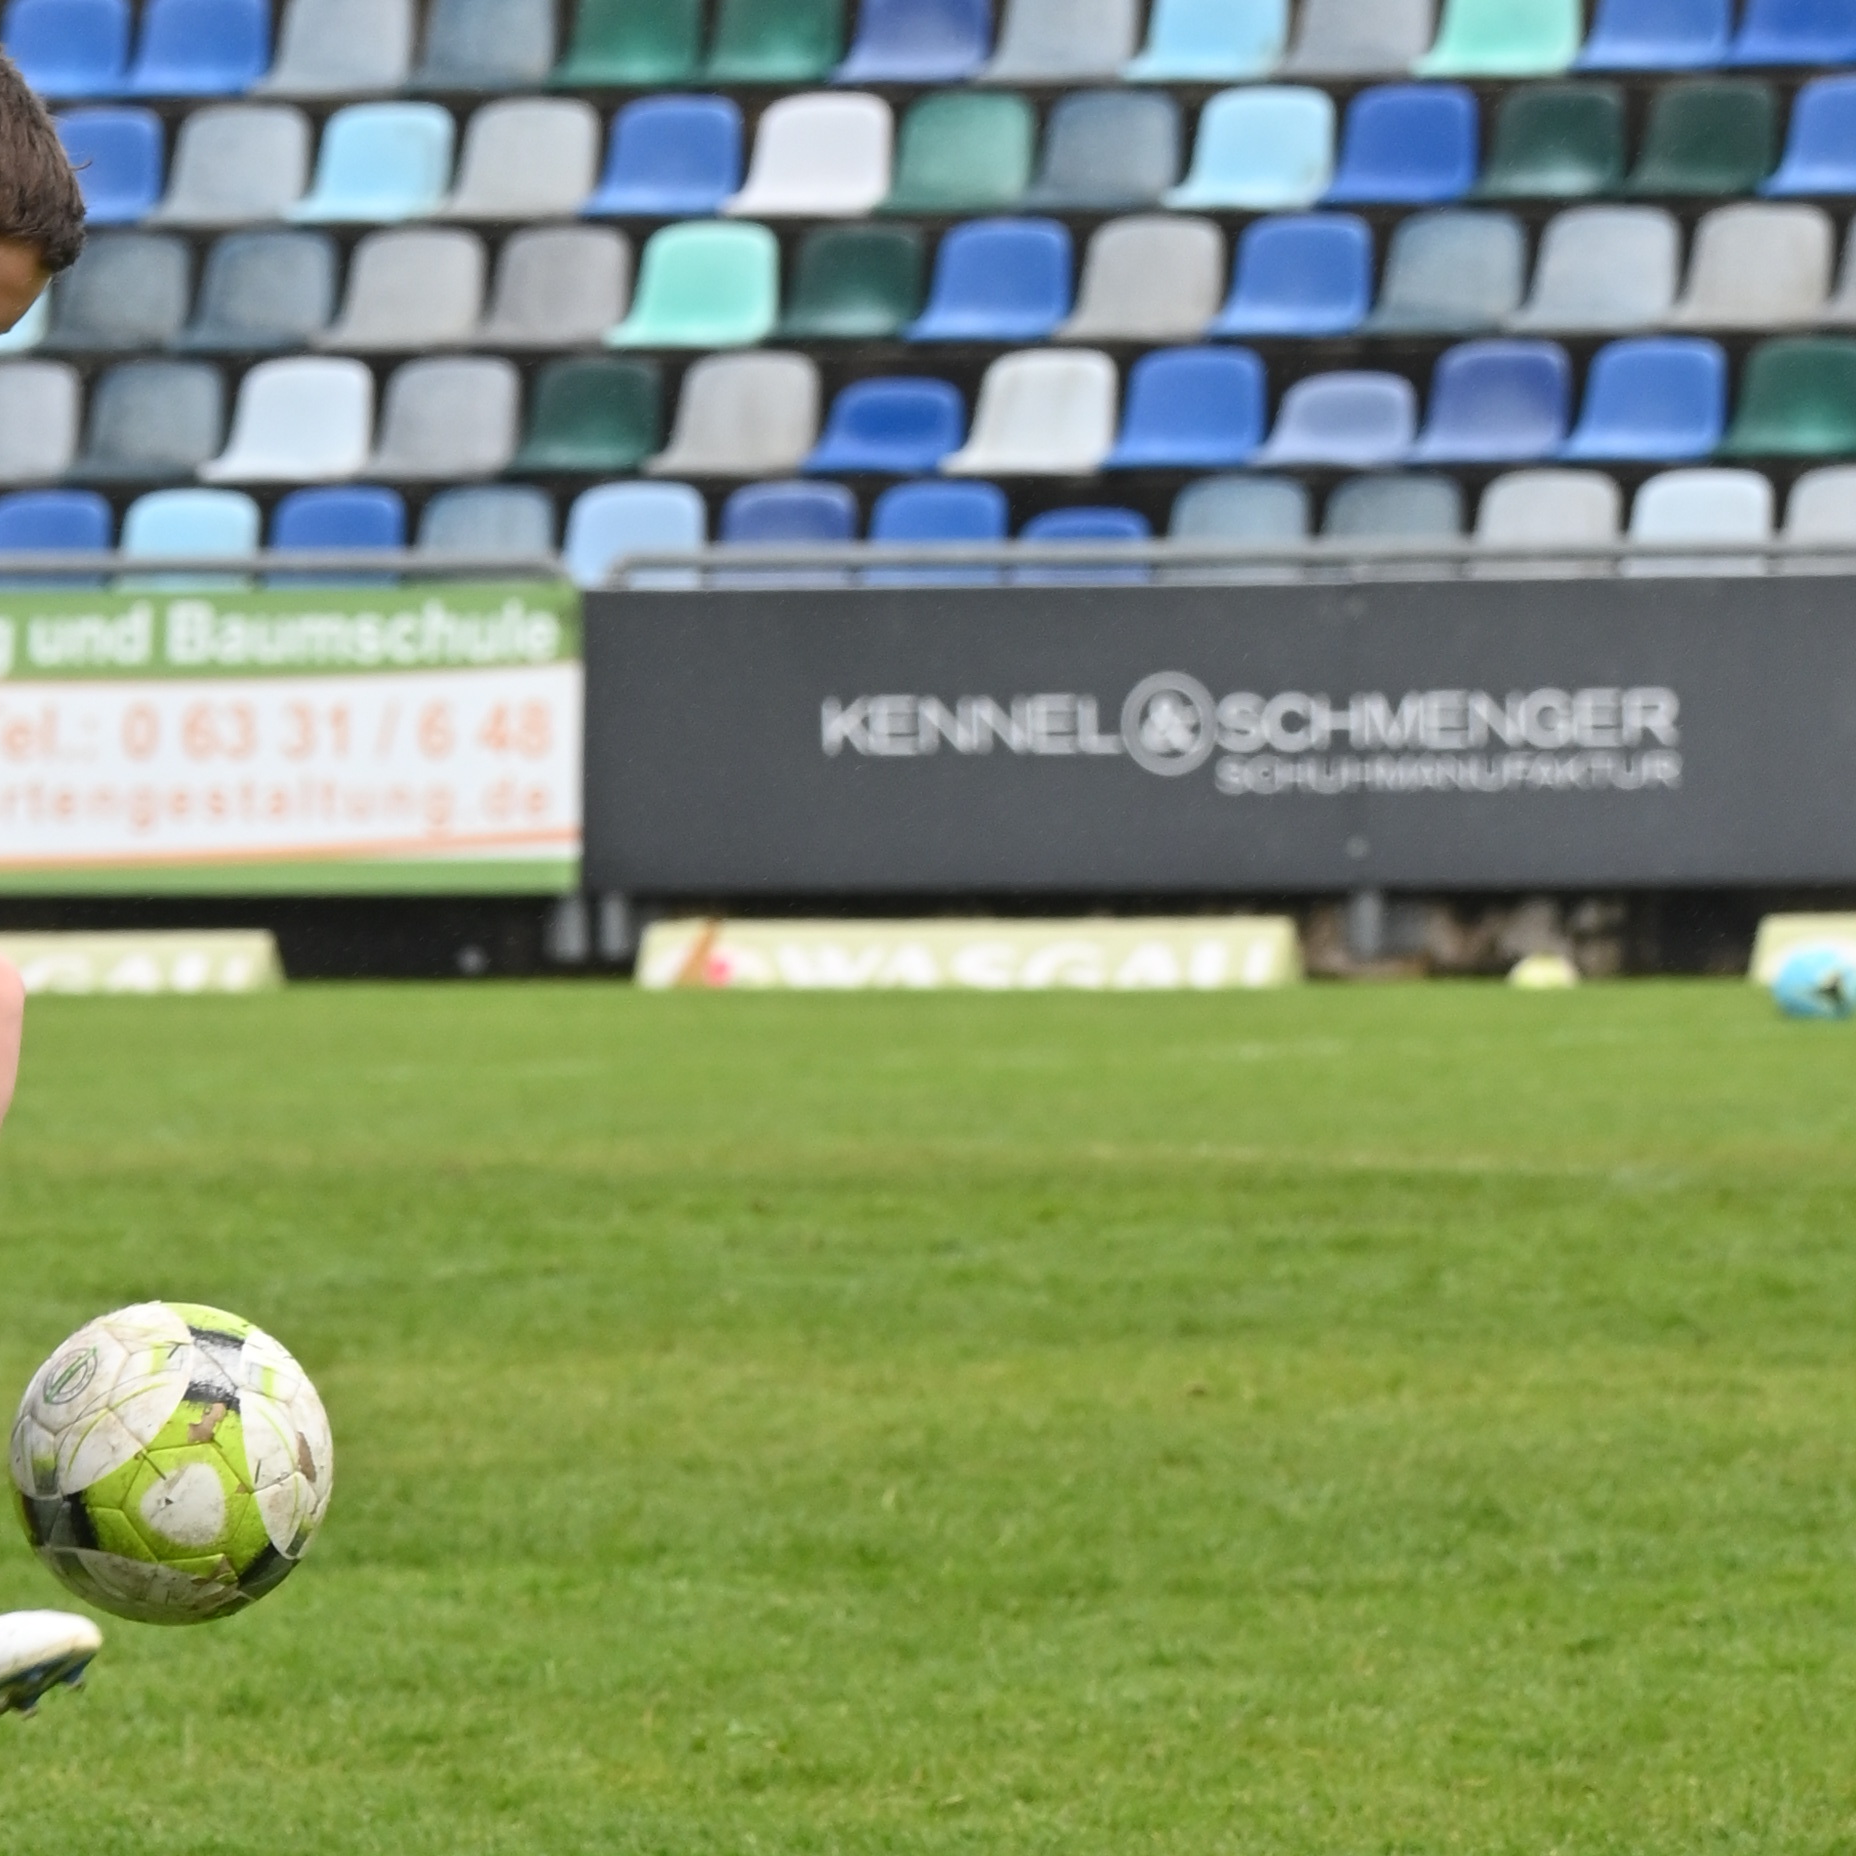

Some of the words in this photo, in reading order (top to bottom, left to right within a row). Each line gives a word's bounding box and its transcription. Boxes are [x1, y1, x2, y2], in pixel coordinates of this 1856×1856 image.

[27, 601, 154, 666] und
[166, 597, 560, 666] Baumschule
[821, 693, 1123, 757] KENNEL
[1216, 686, 1680, 752] SCHMENGER
